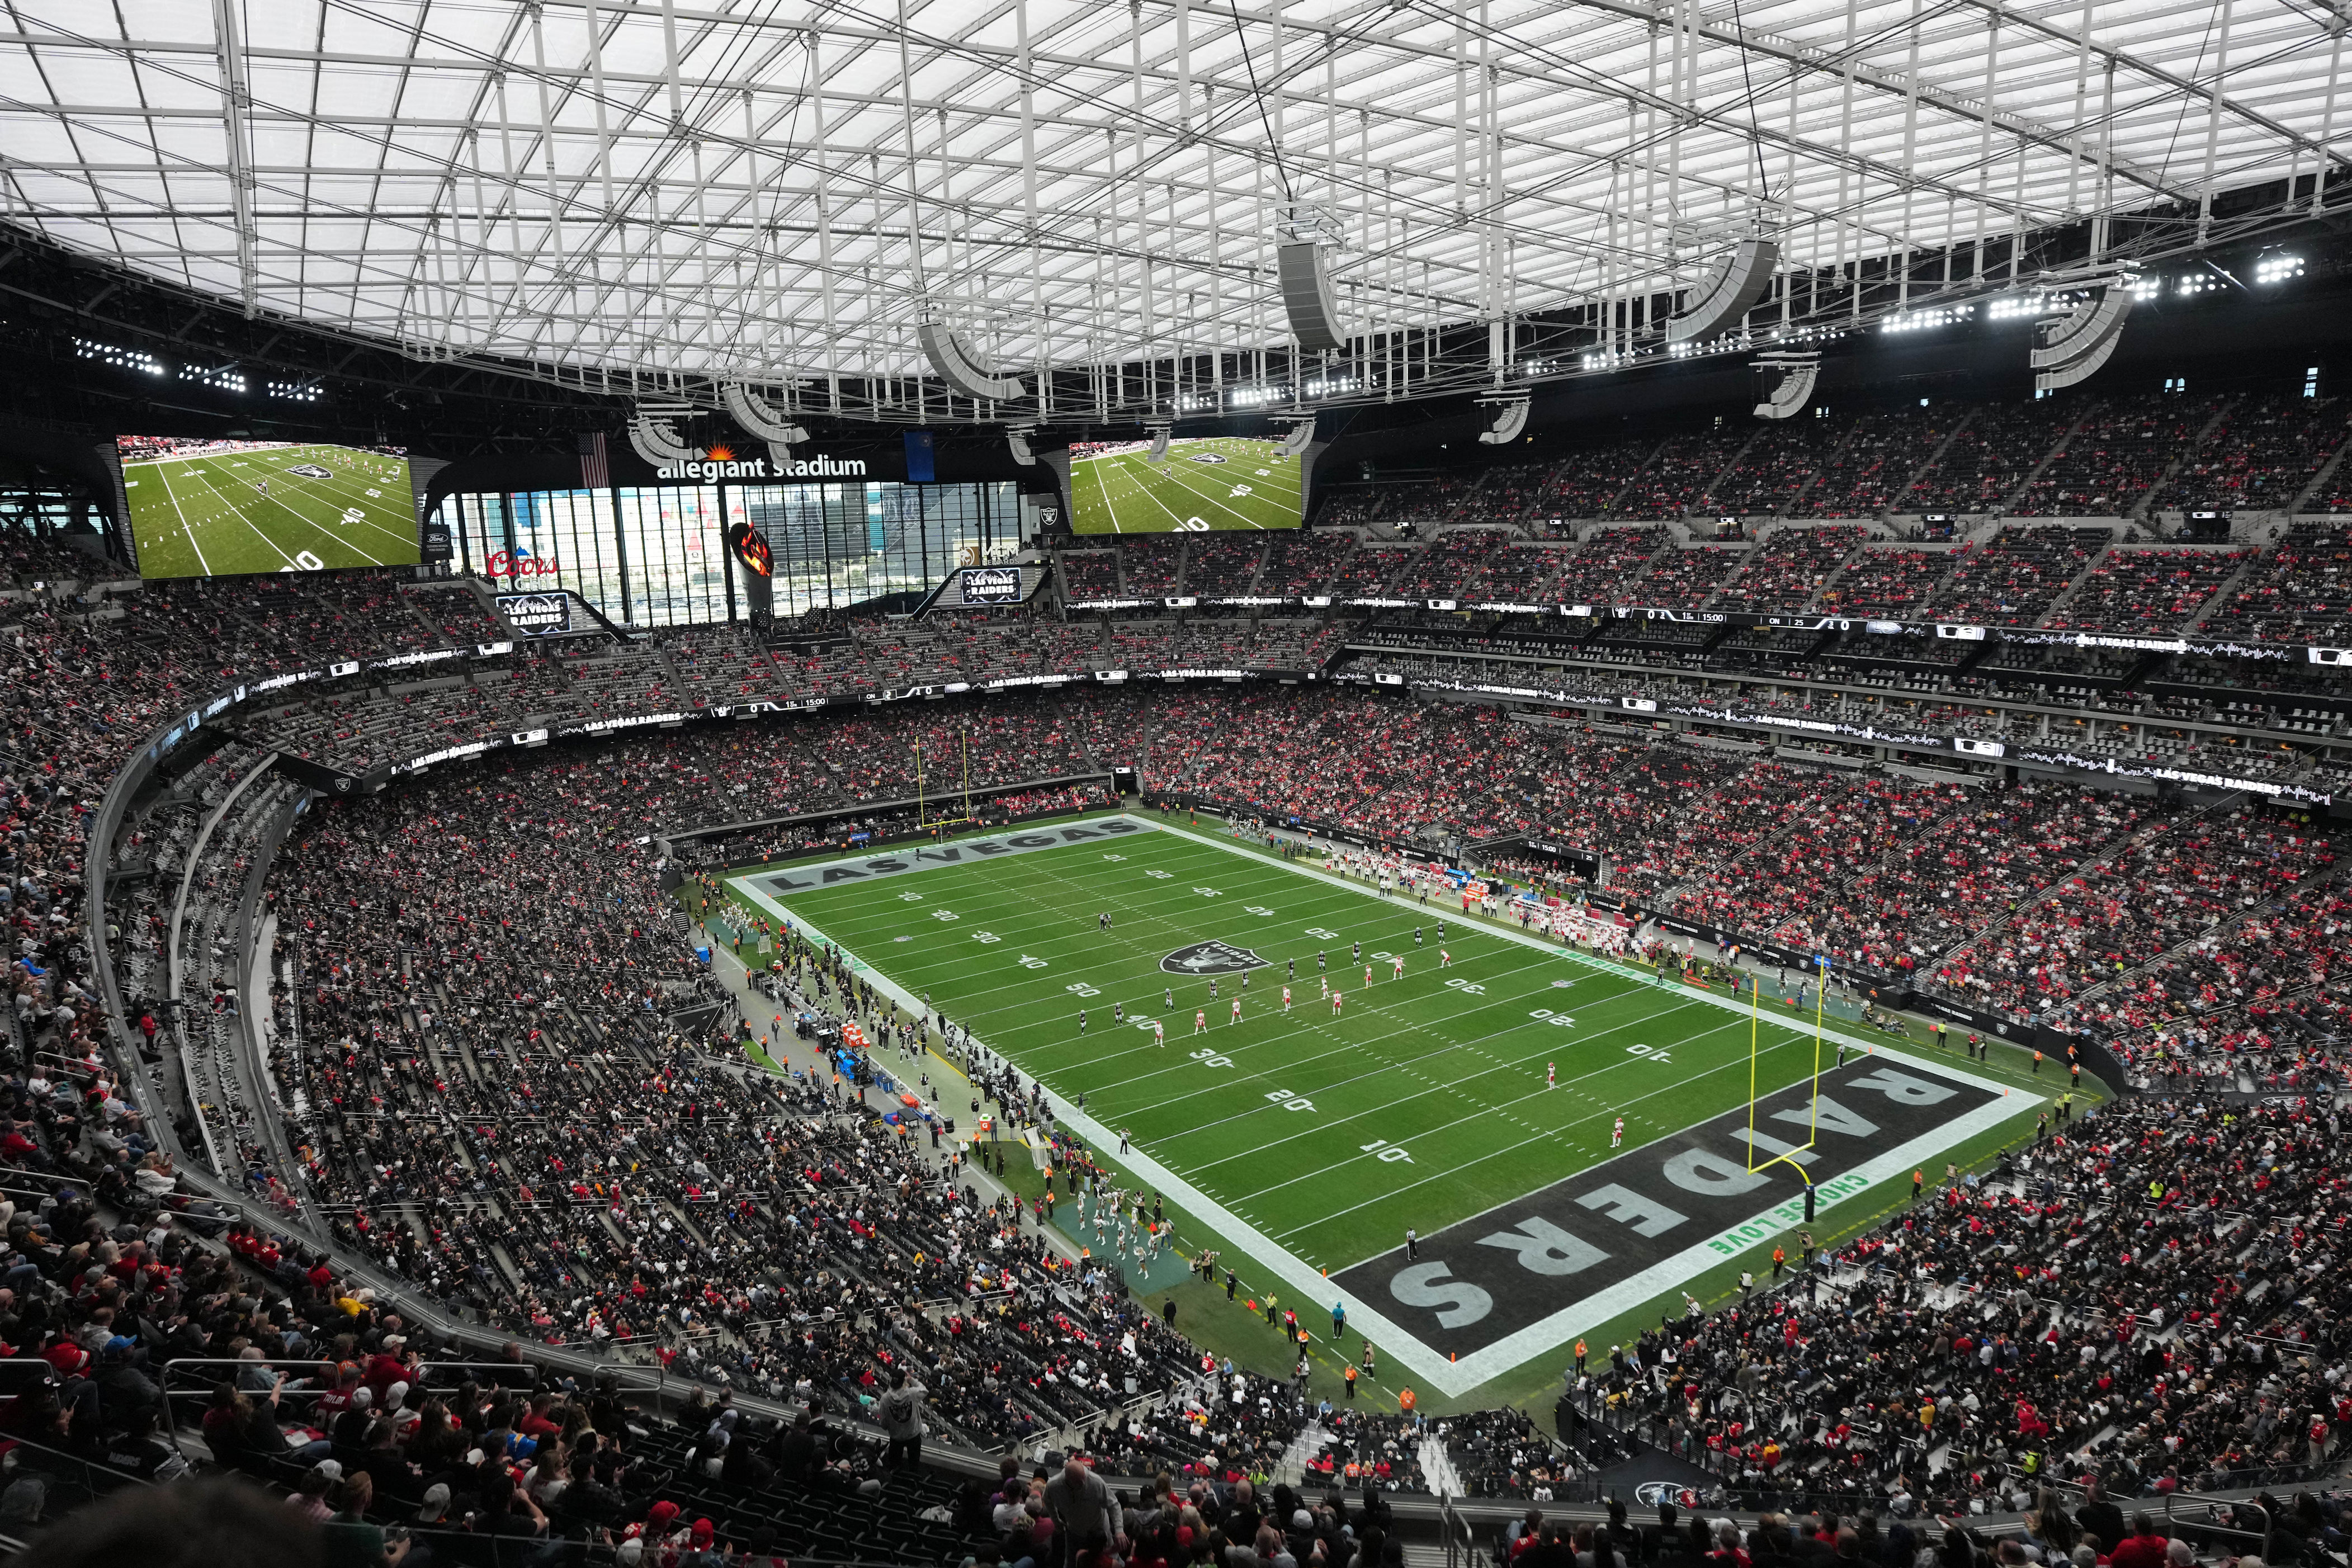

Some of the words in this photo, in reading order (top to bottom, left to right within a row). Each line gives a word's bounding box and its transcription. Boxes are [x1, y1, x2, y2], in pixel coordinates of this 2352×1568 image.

[981, 544, 1019, 558] MGM
[485, 550, 559, 577] Coors
[496, 576, 552, 593] LIGHT
[971, 585, 1014, 595] RAIDERS
[509, 606, 530, 615] LAS
[530, 604, 561, 613] VEGAS
[1647, 610, 1655, 619] 0
[510, 613, 563, 626] RAIDERS
[1840, 620, 1849, 630] 0
[2077, 637, 2098, 645] LAS
[2100, 637, 2136, 648] VEGAS
[2137, 639, 2188, 652] RAIDERS
[401, 654, 422, 664] VEGAS
[423, 650, 452, 662] RAIDERS
[1005, 677, 1032, 686] VEGAS
[1032, 674, 1068, 684] RAIDERS
[585, 722, 604, 731] LAS
[604, 718, 637, 729] VEGAS
[638, 712, 681, 725] RAIDERS
[1773, 717, 1800, 727] VEGAS
[1801, 721, 1836, 732] RAIDERS
[412, 757, 425, 768] LAS
[425, 752, 448, 766] VEGAS
[448, 741, 484, 759] RAIDERS
[2156, 768, 2180, 780] LAS
[2182, 772, 2223, 787] VEGAS
[2224, 777, 2282, 794] RAIDERS
[918, 822, 1137, 862] VEGAS
[1542, 844, 1556, 853] 15:00
[890, 844, 936, 855] TAKES
[768, 859, 909, 890] LAS
[1150, 870, 1174, 879] 20
[898, 893, 923, 901] 10
[1196, 887, 1224, 898] 30
[931, 911, 960, 922] 20
[1248, 906, 1276, 917] 40
[1305, 927, 1339, 940] 50
[1670, 921, 1682, 929] VEGAS
[1682, 925, 1698, 934] RAIDERS
[971, 933, 1001, 944] 30
[1210, 943, 1262, 965] RAIDERS
[1763, 950, 1780, 960] RAIDERS
[1018, 956, 1049, 969] 40
[1552, 950, 1636, 977] AMERICA
[1642, 976, 1682, 990] 250
[1065, 982, 1101, 998] 50
[1444, 979, 1485, 994] 30
[1529, 1009, 1575, 1027] 20
[1952, 1010, 1973, 1022] RAIDERS
[1189, 1049, 1232, 1068] 30
[1626, 1044, 1671, 1062] 10
[1264, 1089, 1313, 1112] 20
[1359, 1140, 1410, 1163] 10
[1390, 1069, 1959, 1329] RAIDERS
[1773, 1175, 1869, 1222] CHOOSE
[1707, 1218, 1780, 1254] LOVE
[323, 1394, 346, 1405] TAYLOR
